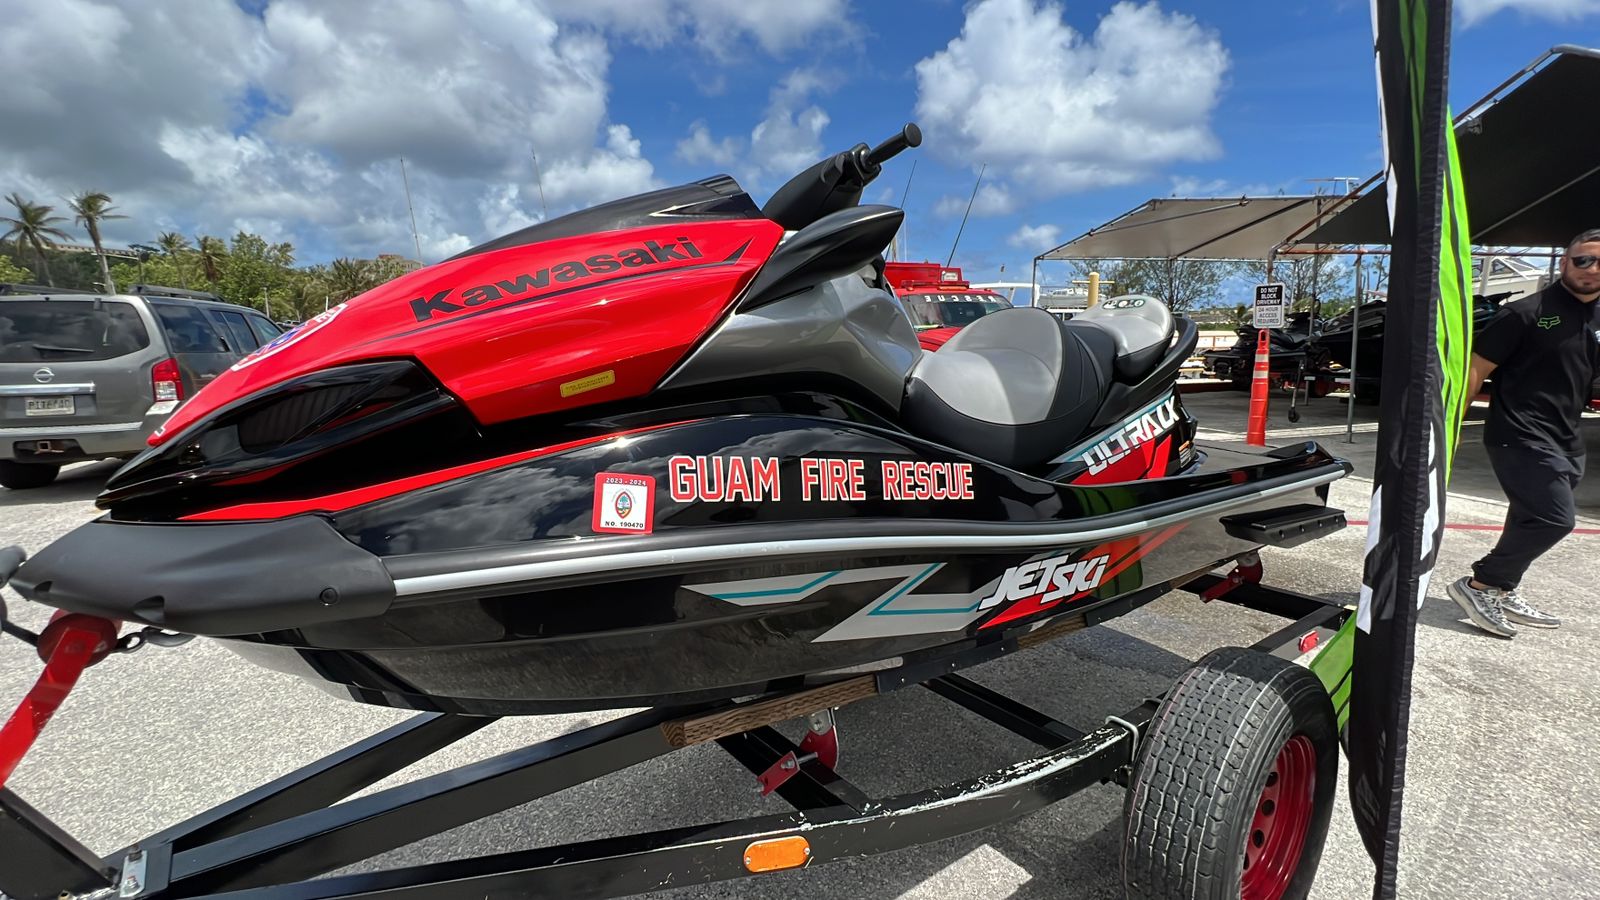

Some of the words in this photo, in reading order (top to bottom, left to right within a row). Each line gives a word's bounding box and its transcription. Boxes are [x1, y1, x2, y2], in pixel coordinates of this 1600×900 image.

[410, 237, 703, 322] Kawasaki
[668, 456, 781, 502] GUAM
[801, 458, 866, 501] FIRE
[881, 461, 974, 500] RESCUE
